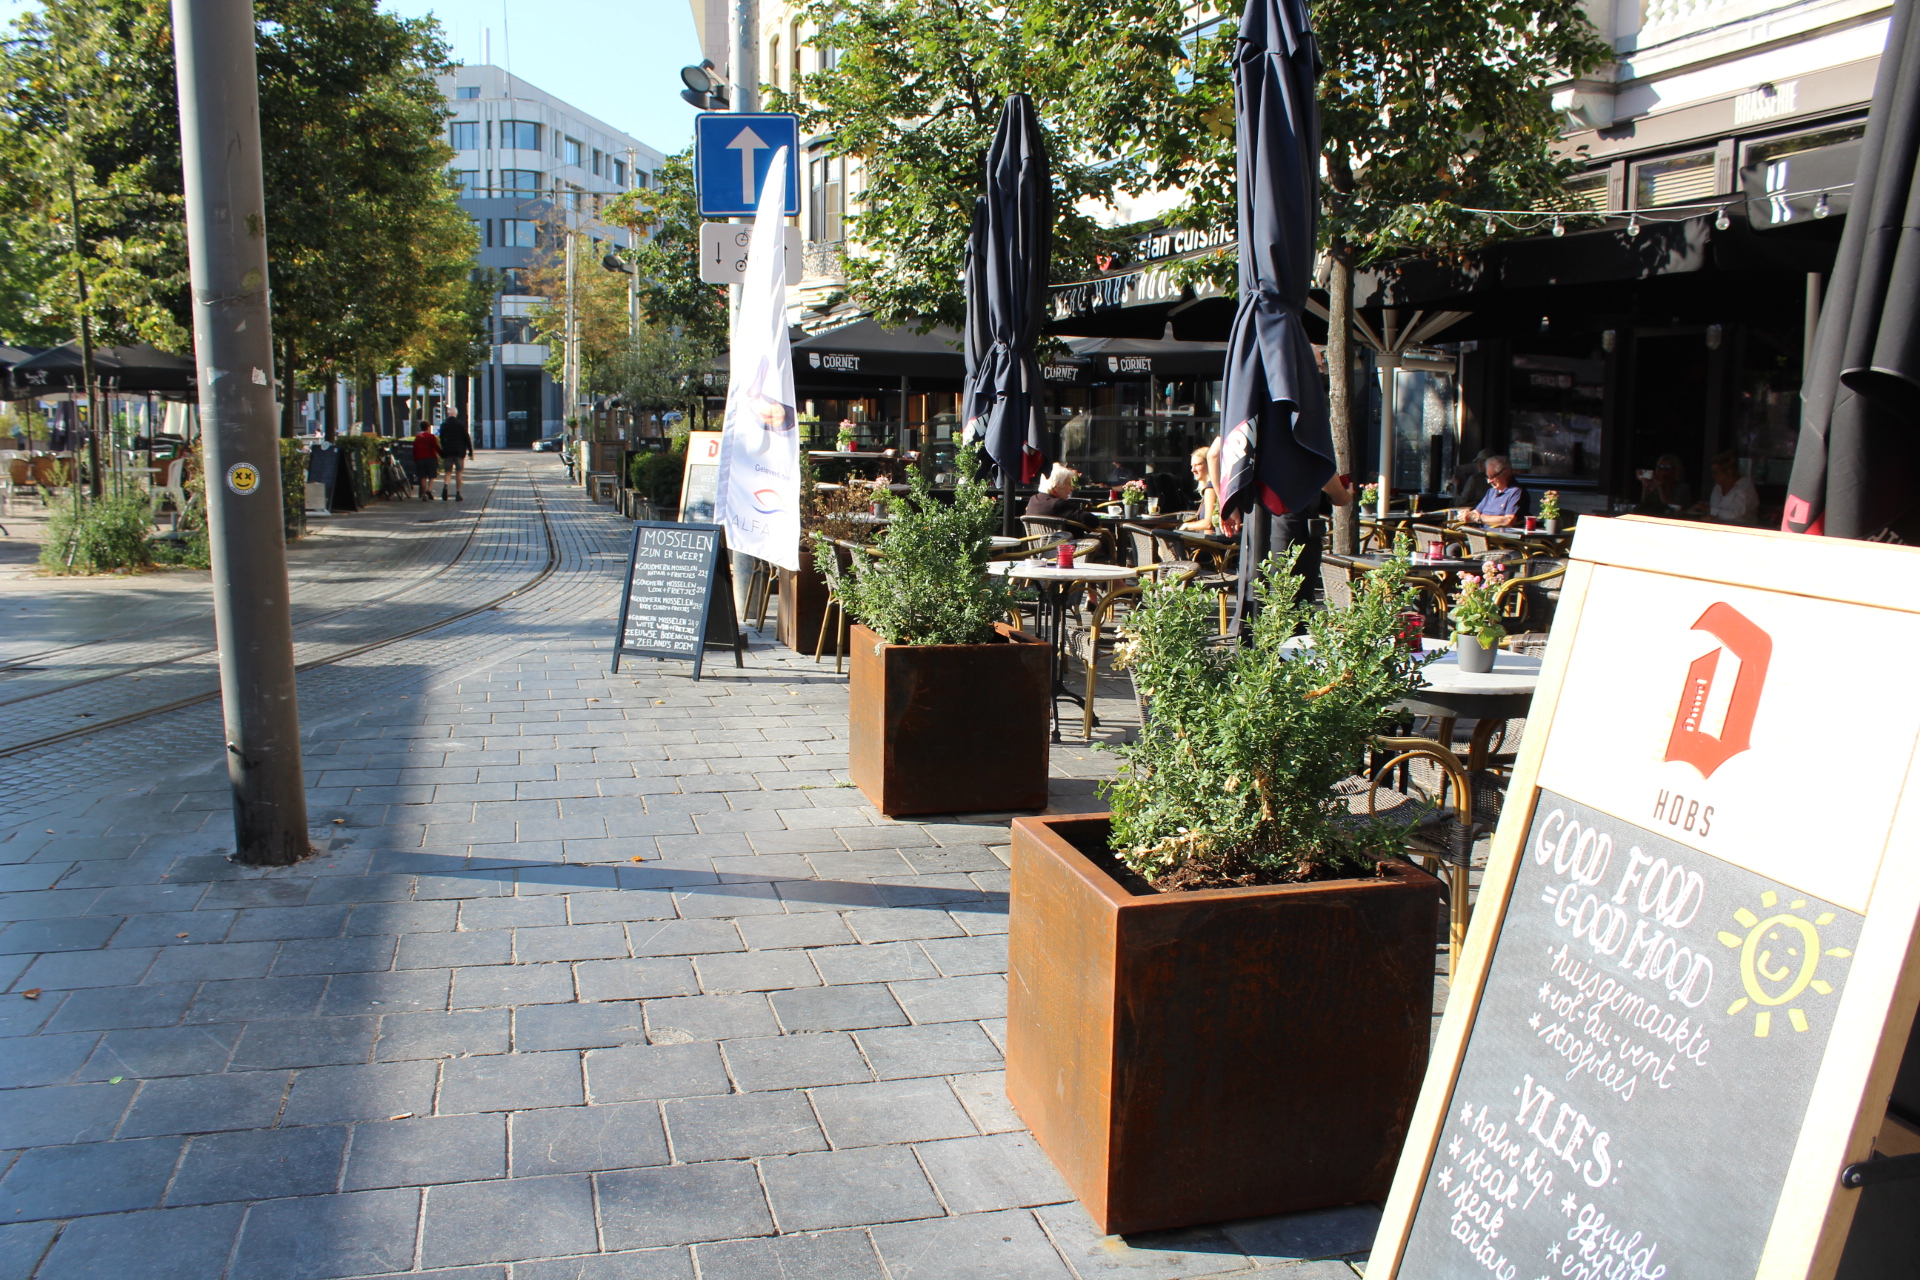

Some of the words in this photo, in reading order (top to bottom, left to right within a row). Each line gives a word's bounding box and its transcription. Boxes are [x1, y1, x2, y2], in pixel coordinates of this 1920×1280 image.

[1132, 232, 1170, 260] sian
[822, 355, 860, 371] CORNET
[1044, 365, 1079, 381] CORNET
[1120, 358, 1152, 371] CORNET
[731, 514, 770, 538] ALFA
[643, 530, 713, 552] MOSSELEN
[663, 549, 673, 559] ER
[676, 551, 704, 562] WEER!
[624, 628, 658, 639] ZEEUWSE
[1653, 789, 1714, 837] HOBS
[1534, 808, 1612, 886] GOOD
[1611, 845, 1704, 929] FOOD
[1618, 919, 1714, 1008] MOOD
[1472, 1104, 1521, 1168] halve
[1520, 1147, 1554, 1210] kip
[1460, 1148, 1518, 1210] steak
[1448, 1180, 1504, 1238] steak
